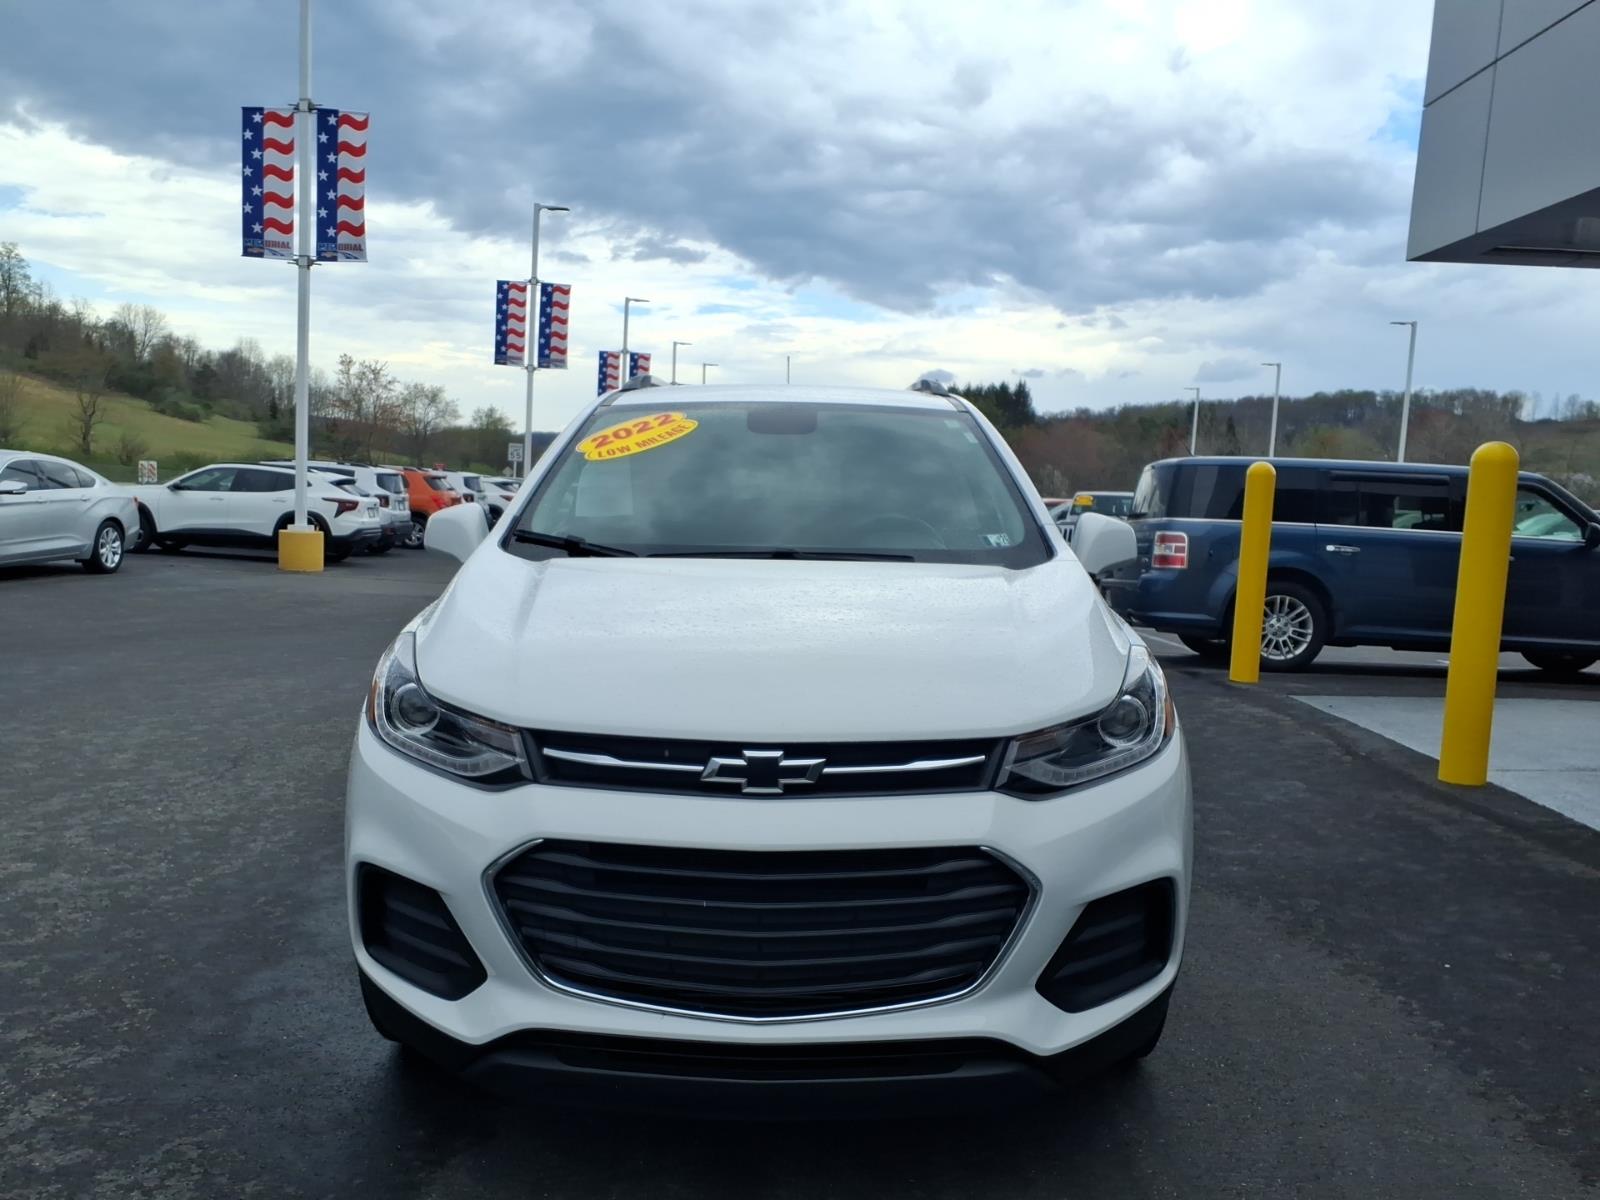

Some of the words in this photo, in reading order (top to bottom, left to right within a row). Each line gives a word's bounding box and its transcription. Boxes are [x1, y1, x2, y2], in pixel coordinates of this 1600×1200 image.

[591, 414, 677, 449] 2022
[598, 445, 631, 458] LOW
[635, 424, 690, 448] MILEAGE
